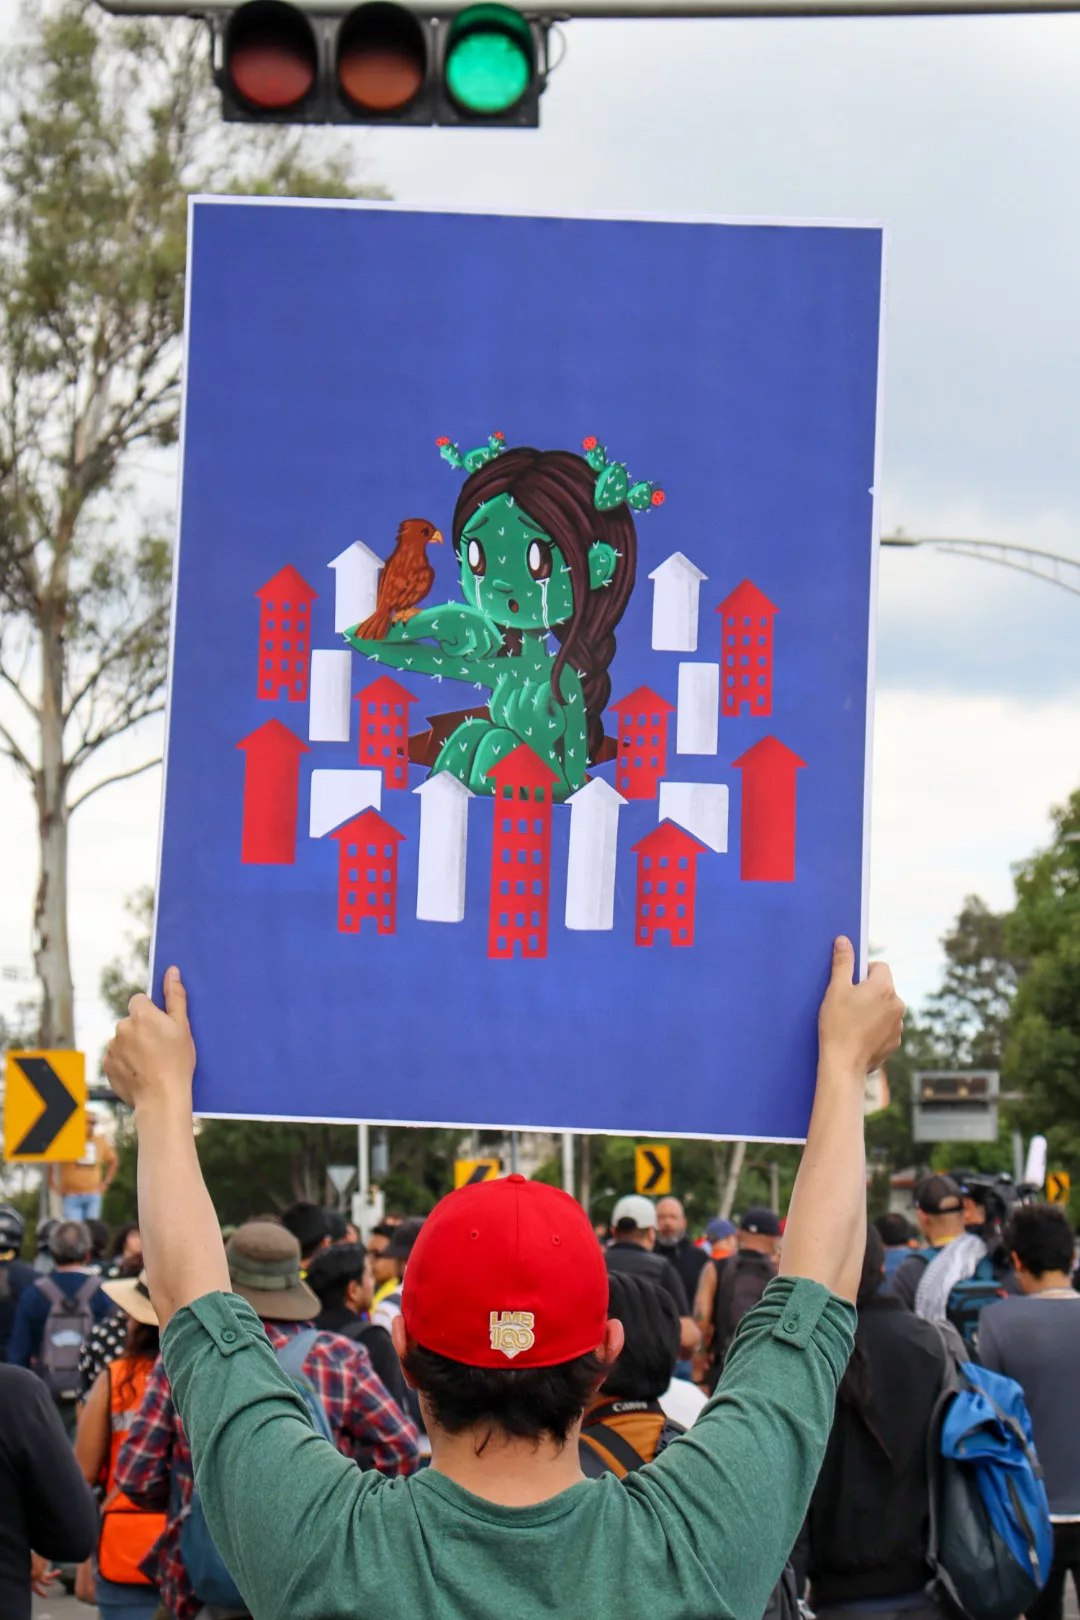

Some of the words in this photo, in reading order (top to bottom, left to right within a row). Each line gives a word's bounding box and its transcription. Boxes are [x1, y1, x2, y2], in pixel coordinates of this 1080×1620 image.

[490, 1311, 534, 1328] LMB
[490, 1327, 535, 1351] 100
[612, 1401, 648, 1412] Canon
